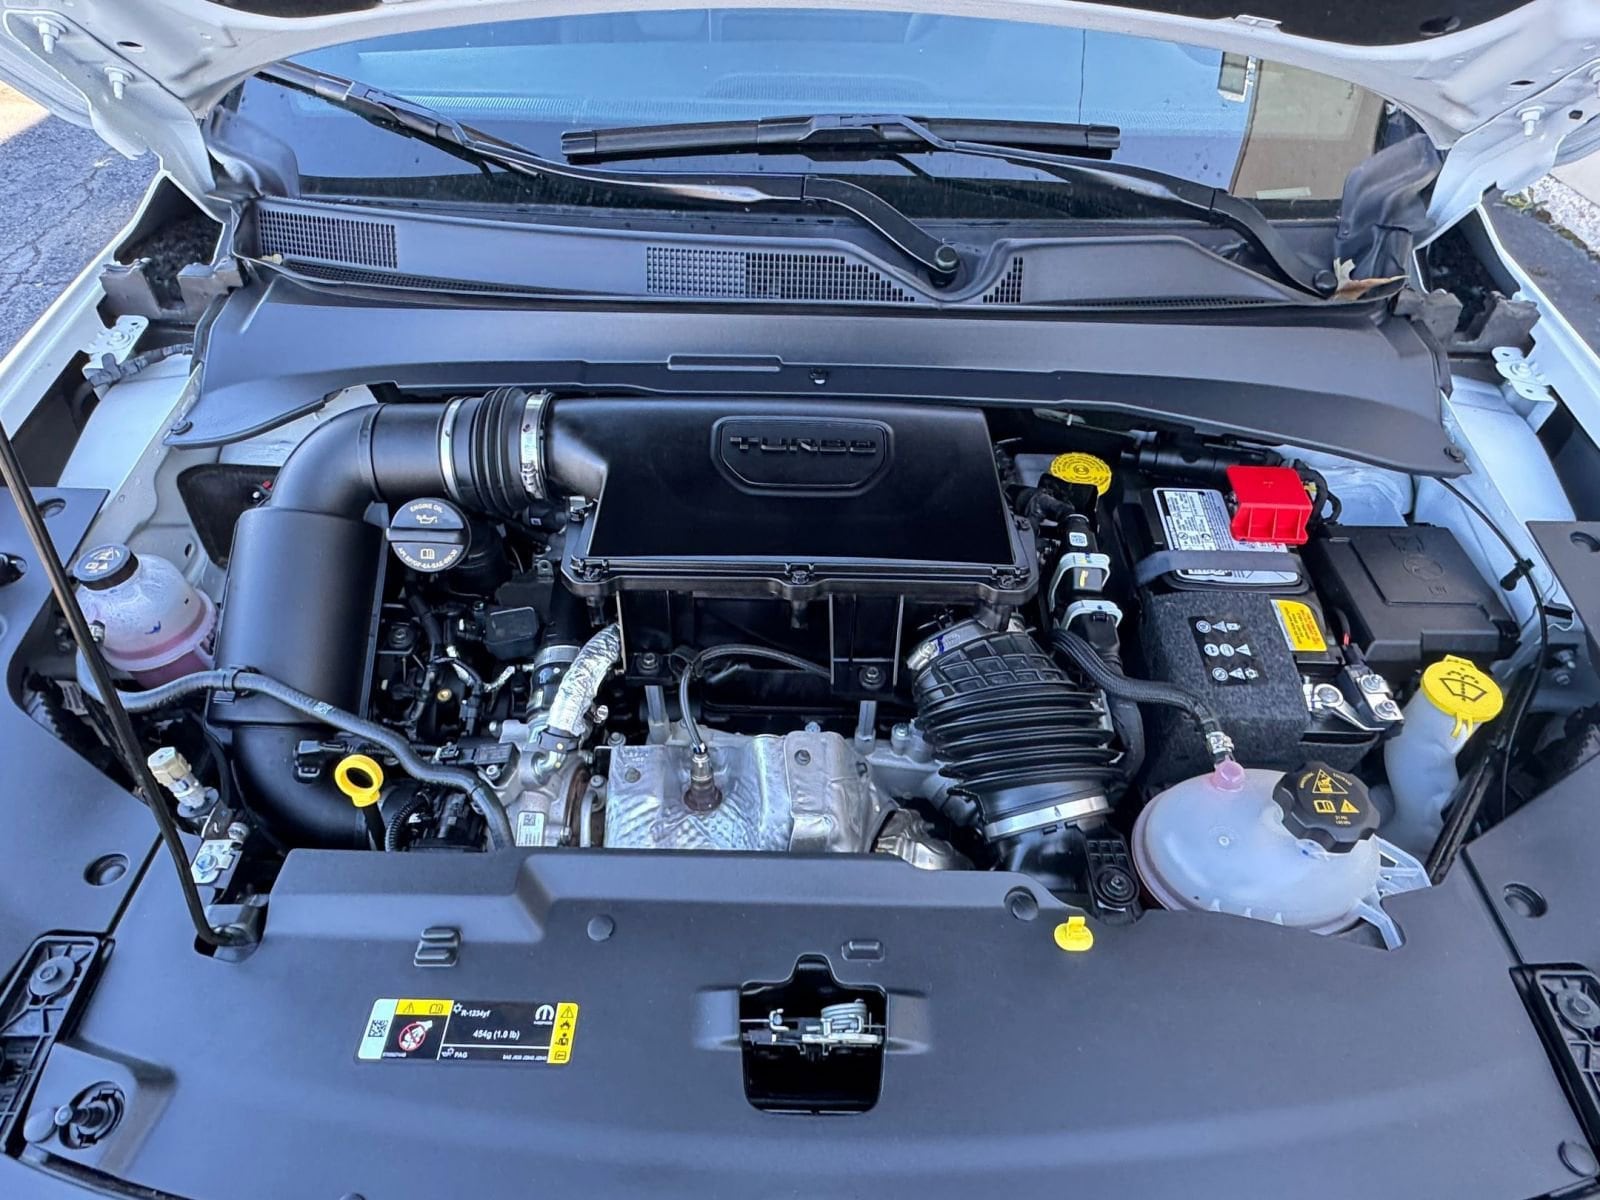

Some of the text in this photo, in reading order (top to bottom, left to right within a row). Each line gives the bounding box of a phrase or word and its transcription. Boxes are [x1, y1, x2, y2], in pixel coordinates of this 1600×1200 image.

[730, 436, 877, 455] TURBO
[410, 503, 443, 513] ENGINE OIL
[461, 1009, 491, 1018] R-1234yf
[472, 1029, 520, 1040] 454g (1.0 lb)
